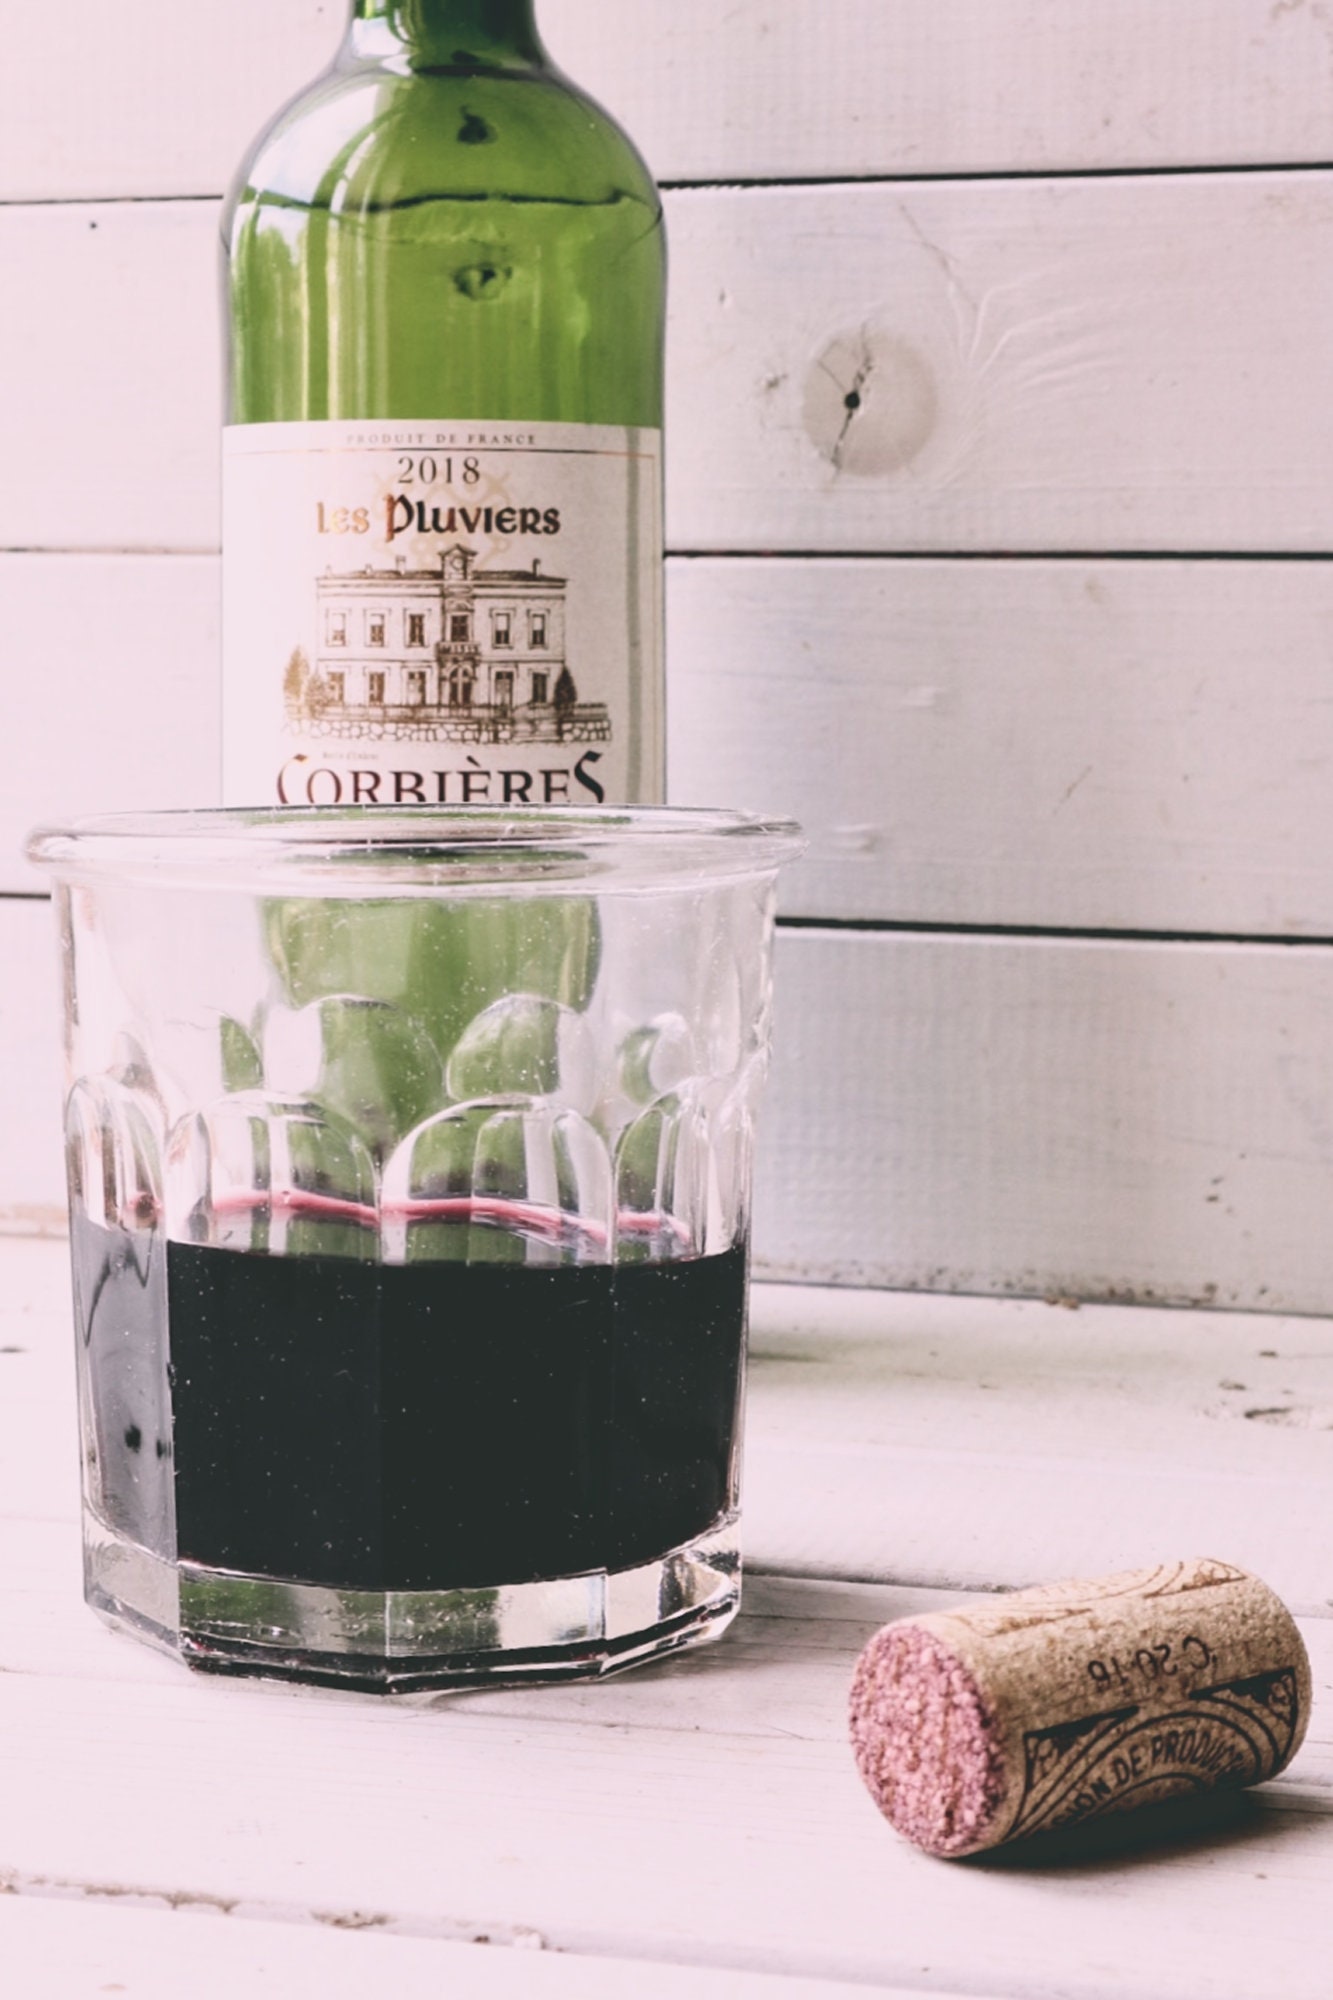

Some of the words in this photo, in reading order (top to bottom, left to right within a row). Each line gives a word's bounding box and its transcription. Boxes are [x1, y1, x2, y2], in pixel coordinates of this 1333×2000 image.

[346, 433, 424, 445] PRODUIT
[435, 433, 457, 445] DE
[467, 433, 537, 446] FRANCE
[398, 456, 481, 485] 2018
[317, 501, 370, 535] LES
[384, 494, 561, 543] PLUVIERS
[1112, 1744, 1145, 1787] DE
